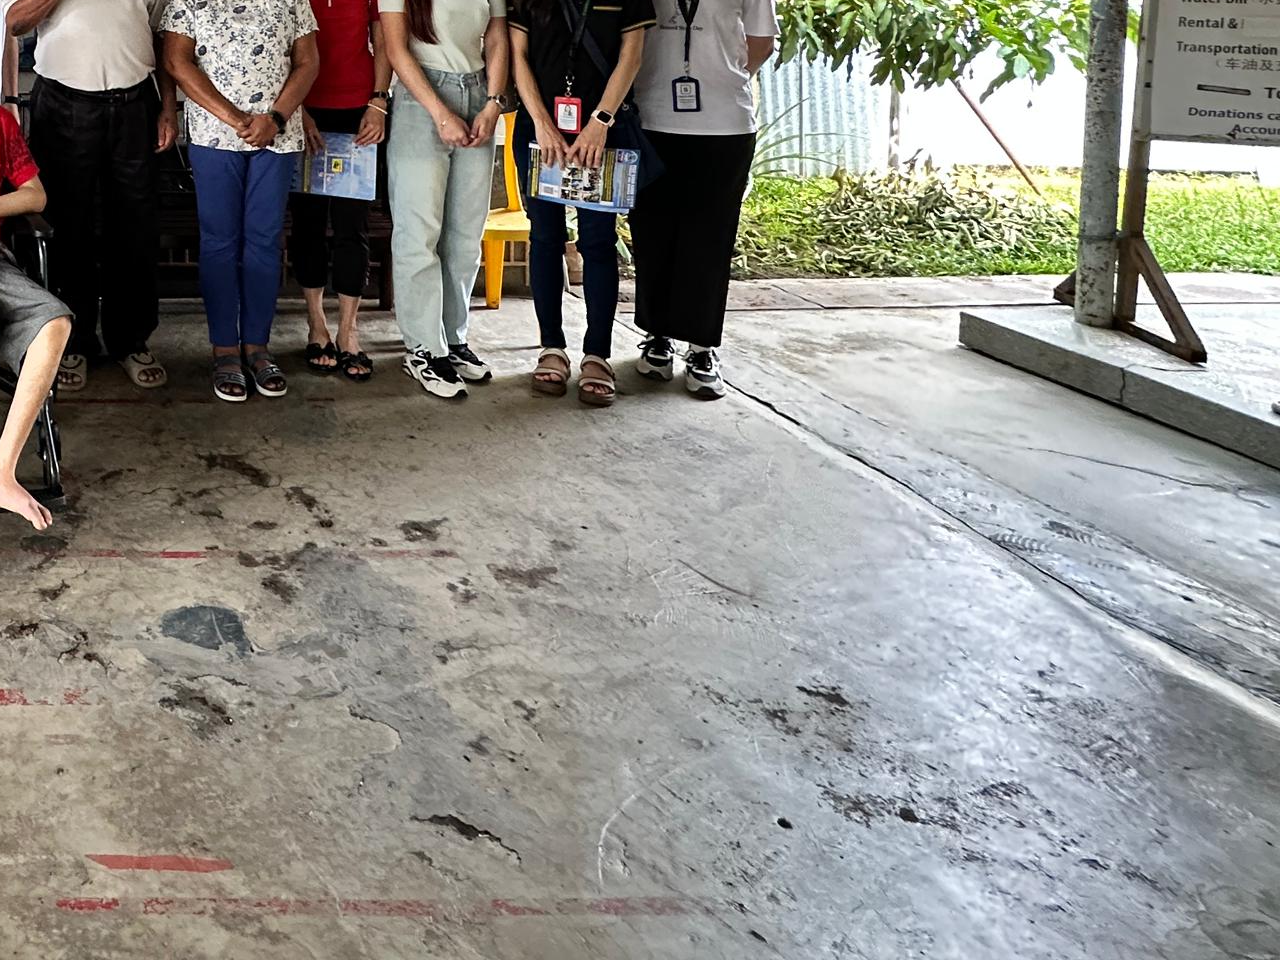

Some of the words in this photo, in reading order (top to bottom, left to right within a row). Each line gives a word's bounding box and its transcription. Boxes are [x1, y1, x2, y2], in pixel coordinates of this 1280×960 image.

[1178, 16, 1225, 29] Rental
[1227, 18, 1238, 29] &
[1176, 41, 1278, 56] Transportation
[1188, 106, 1263, 120] Donations
